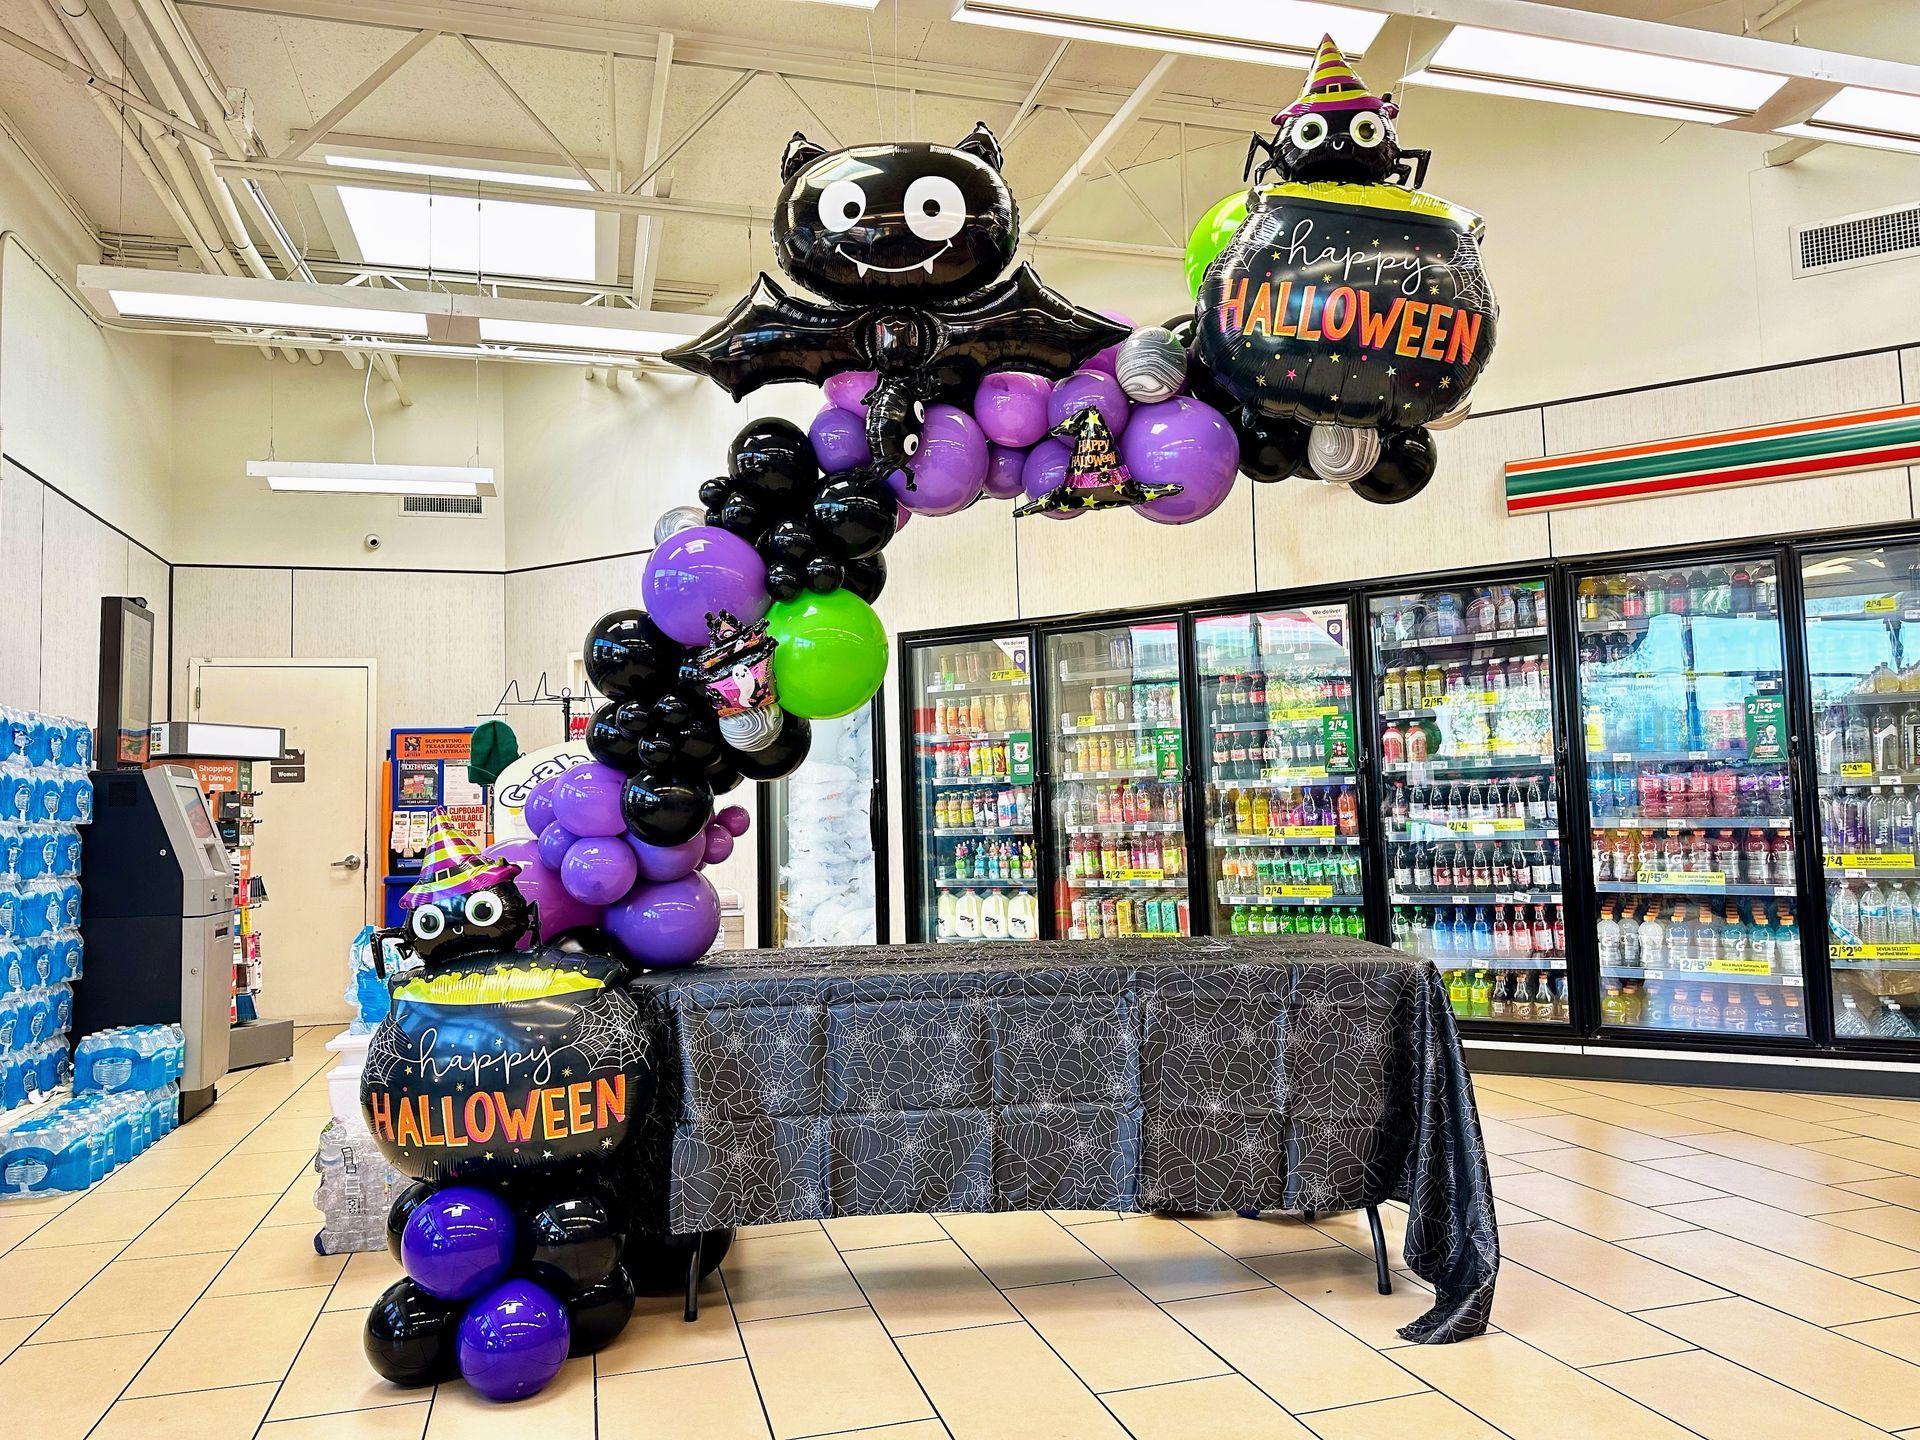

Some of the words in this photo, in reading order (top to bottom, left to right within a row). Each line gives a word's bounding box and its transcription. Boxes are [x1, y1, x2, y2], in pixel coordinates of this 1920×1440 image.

[1287, 218, 1424, 296] happy
[1219, 278, 1482, 366] HALLOWEEN
[1077, 438, 1110, 454] HAPPY
[1328, 719, 1349, 731] 2/$4
[199, 764, 234, 774] Shopping
[208, 774, 232, 783] Dining
[448, 806, 485, 815] CLIPBOARD
[450, 813, 484, 822] AVAILABLE
[461, 829, 482, 837] QUEST
[1265, 886, 1283, 897] 2/$4
[1830, 946, 1863, 958] 2/$250
[1682, 960, 1713, 971] 2/$550
[419, 1028, 556, 1086] happy
[371, 1073, 626, 1148] HALLOWEEN
